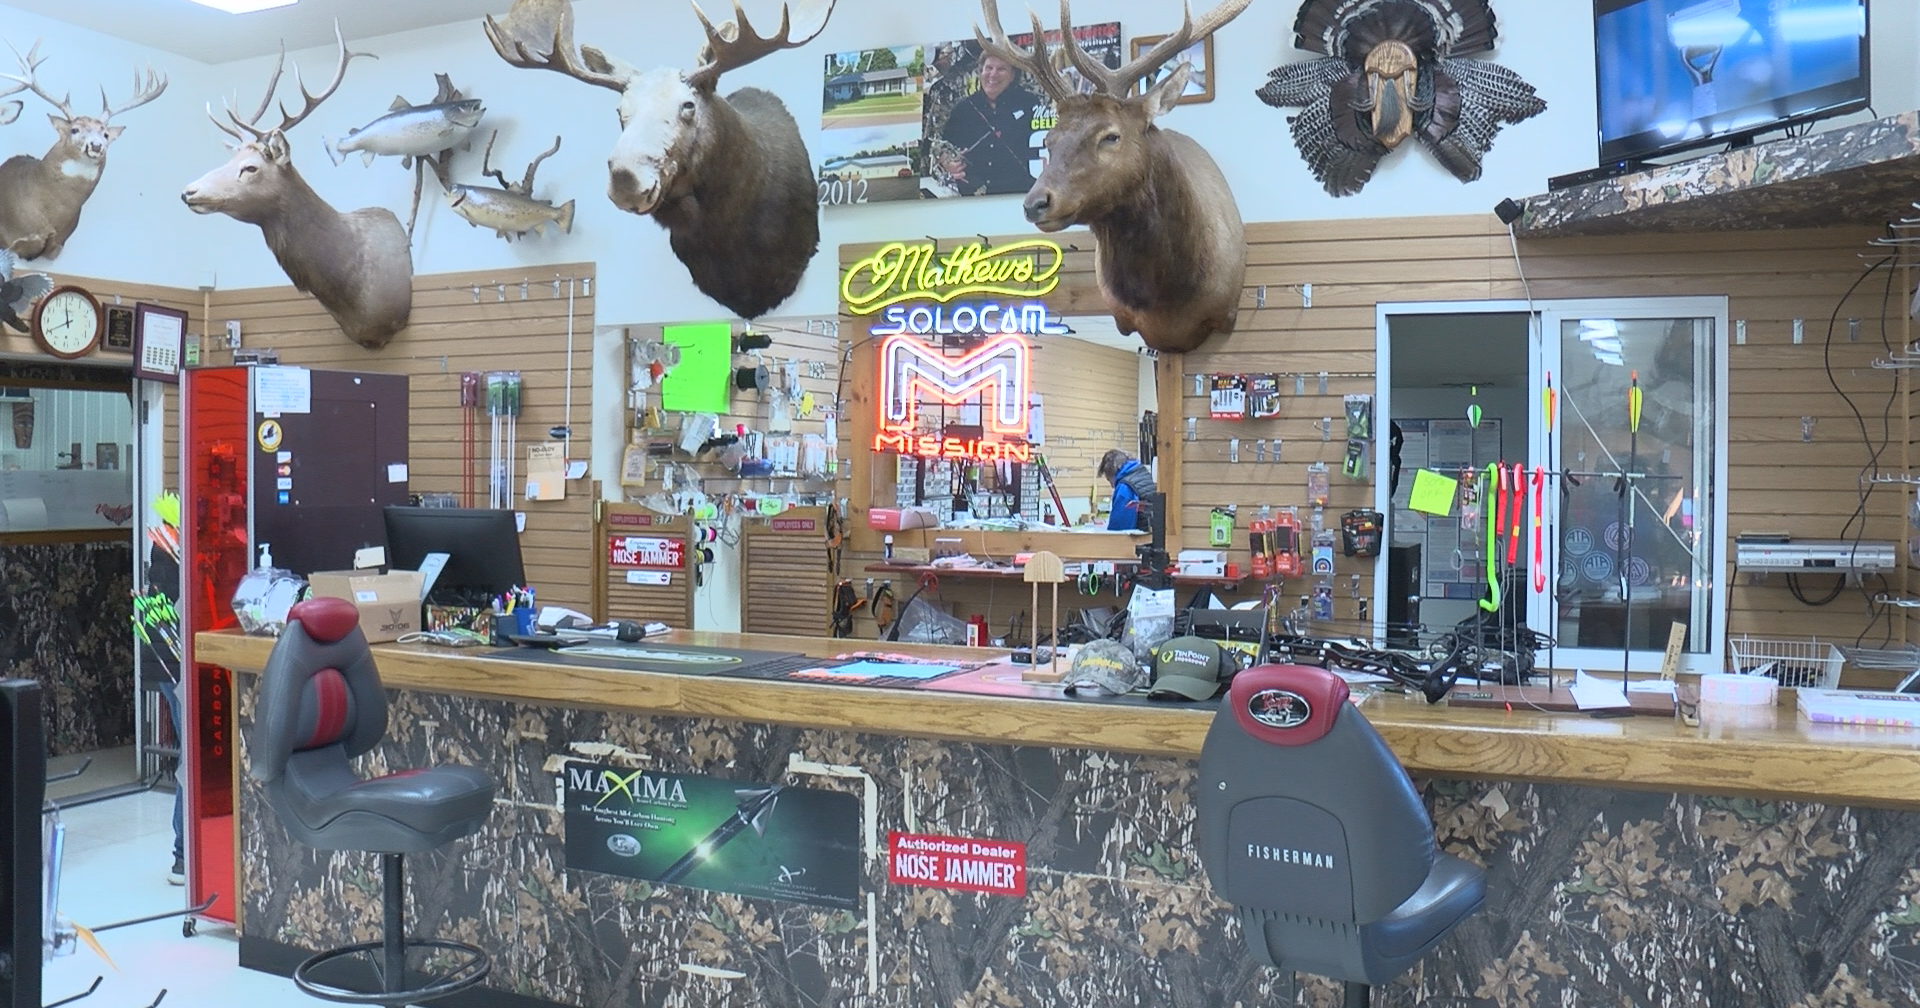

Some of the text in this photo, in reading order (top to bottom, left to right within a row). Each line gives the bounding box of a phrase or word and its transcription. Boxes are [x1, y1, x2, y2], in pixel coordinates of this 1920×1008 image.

[825, 50, 875, 76] 1977
[818, 179, 869, 205] 2012
[842, 239, 1063, 315] Mathews
[870, 304, 1075, 336] SOLOCAM
[875, 433, 1031, 462] MISSION
[611, 514, 638, 524] EMPLOYEES
[774, 520, 814, 529] EMPLOYEES ONLY
[613, 549, 679, 565] NOSE JAMMER
[212, 667, 223, 757] CARBON
[569, 767, 687, 806] MAXIMA
[580, 804, 592, 812] The
[897, 836, 1017, 859] Authorized Dealer
[1247, 843, 1334, 869] FISHERMAN
[895, 853, 1016, 889] NOSE JAMMER
